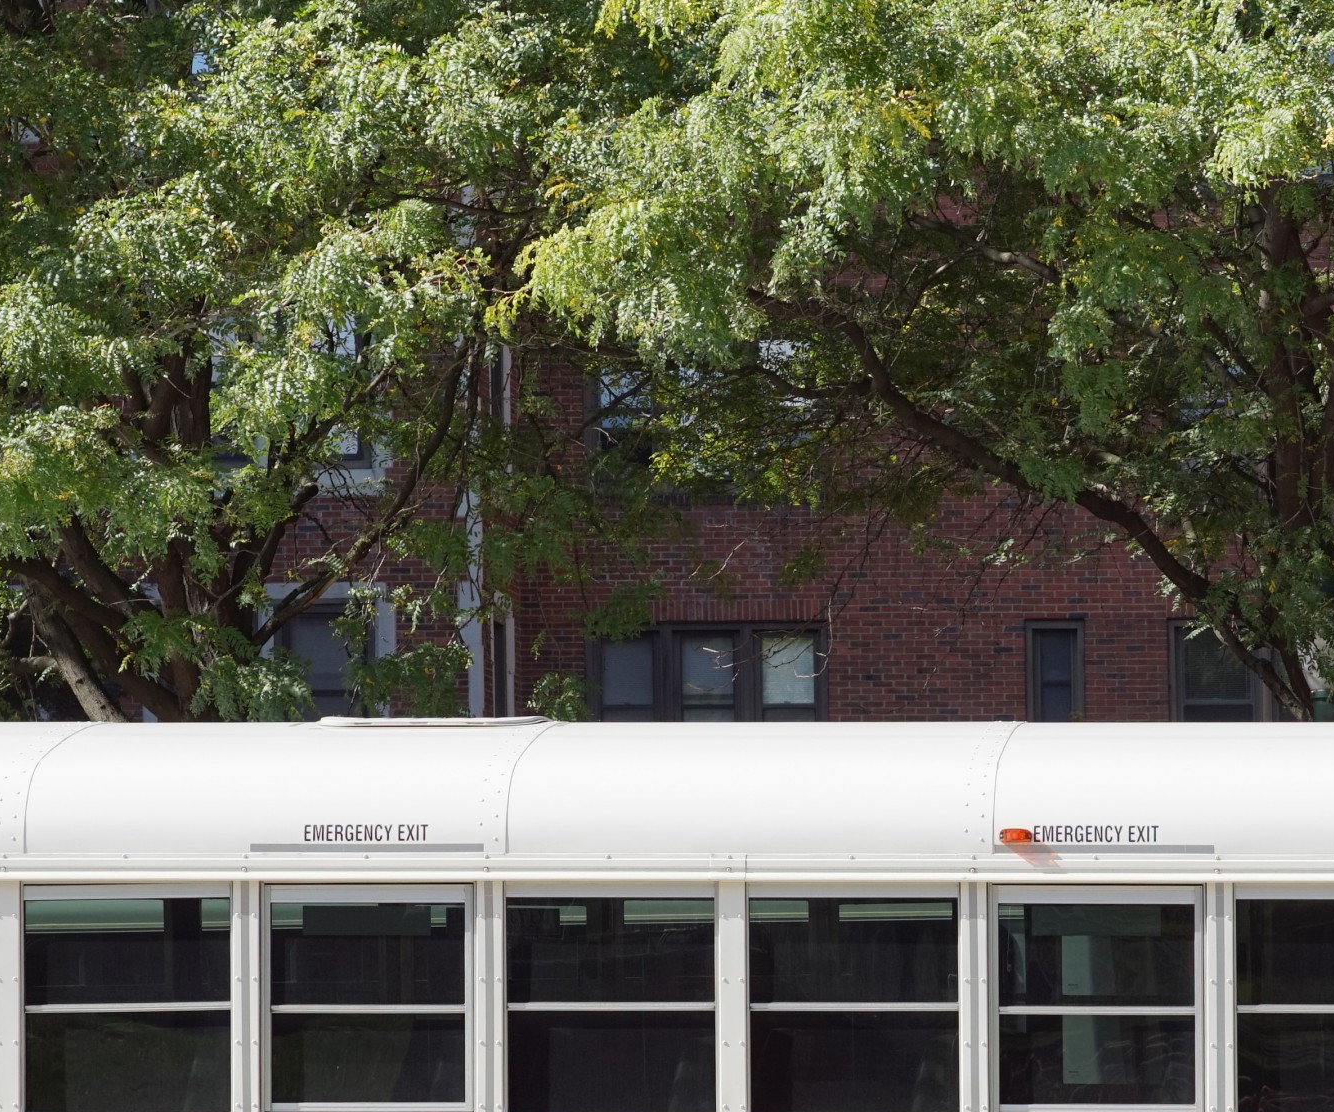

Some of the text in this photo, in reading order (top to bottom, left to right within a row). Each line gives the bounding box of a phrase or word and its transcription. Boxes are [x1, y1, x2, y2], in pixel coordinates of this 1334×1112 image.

[304, 824, 429, 842] EMERGENCY EXIT
[1033, 825, 1159, 843] EMERGENCY EXIT
